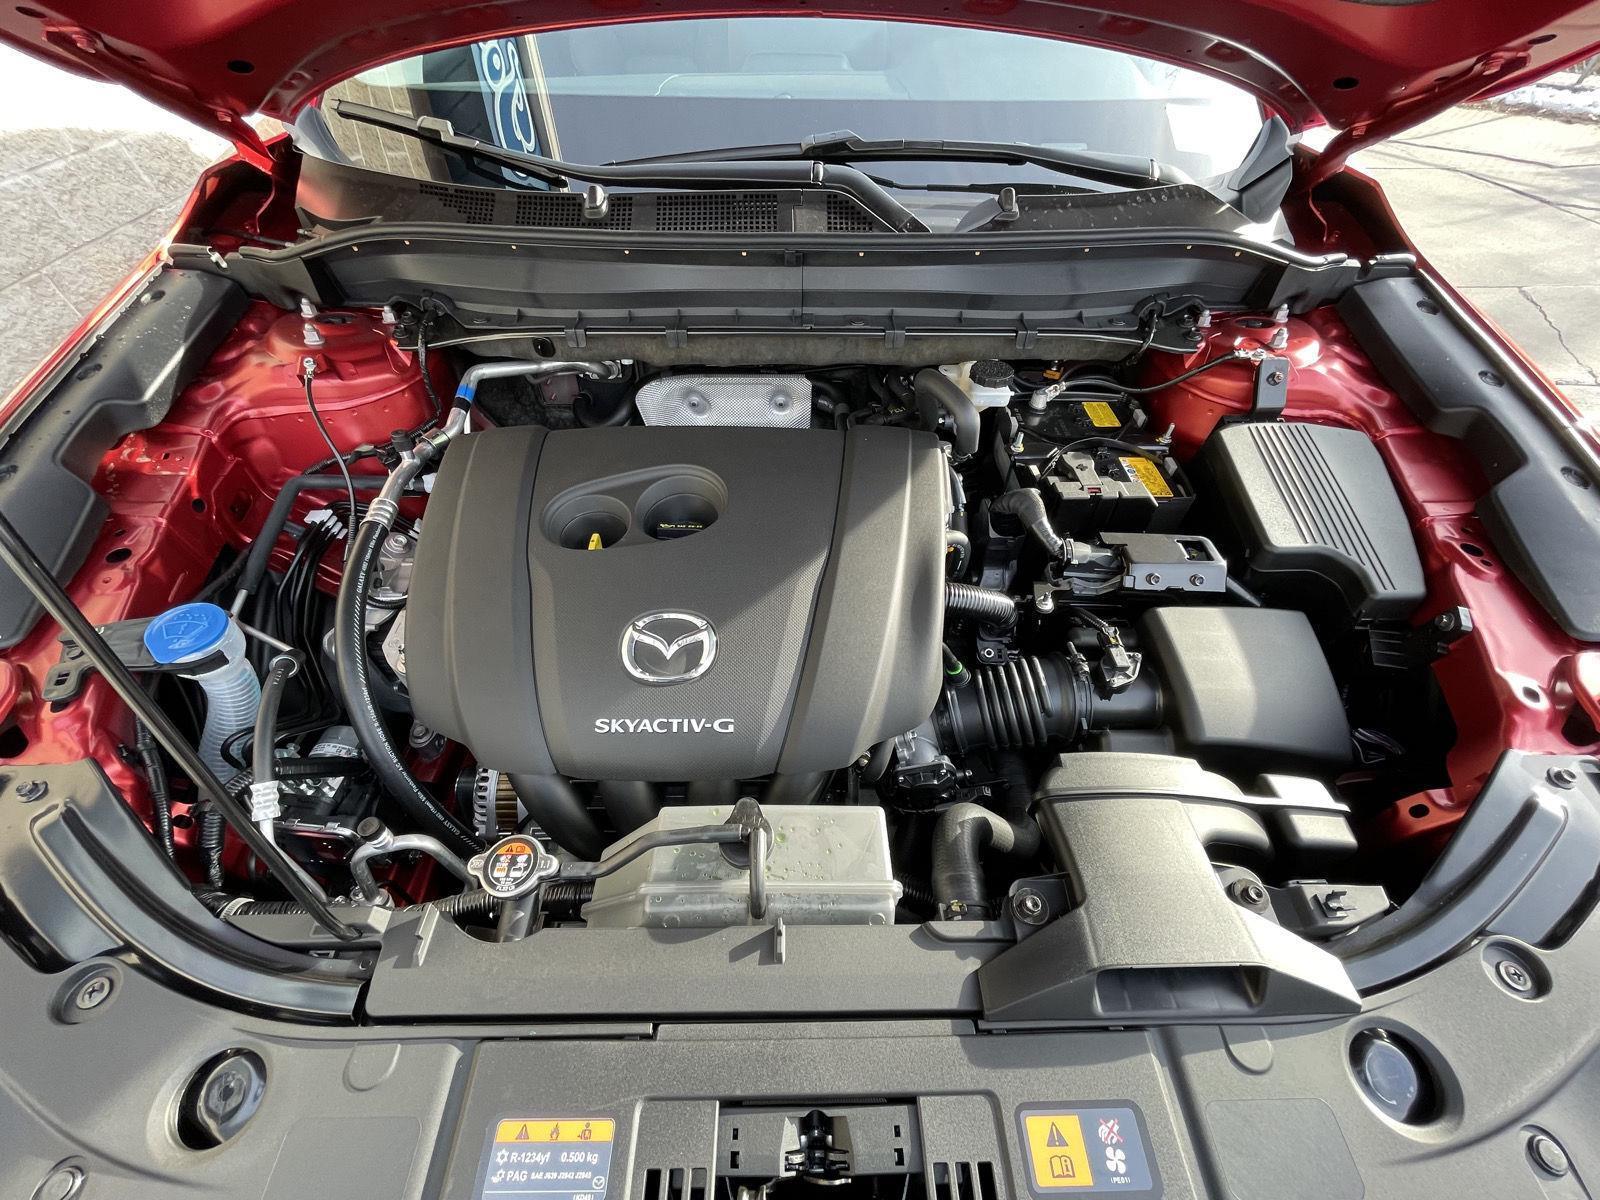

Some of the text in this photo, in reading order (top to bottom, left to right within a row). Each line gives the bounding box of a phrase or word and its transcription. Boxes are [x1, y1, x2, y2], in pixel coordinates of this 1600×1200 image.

[356, 572, 365, 593] GALAXY
[594, 718, 735, 733] SKYACTIV-G
[375, 727, 387, 742] HOSE
[382, 741, 398, 763] SUCTION
[443, 819, 461, 836] GALAXY
[510, 1152, 598, 1165] R-1234yf 0.500 kg
[507, 1171, 528, 1182] PAG
